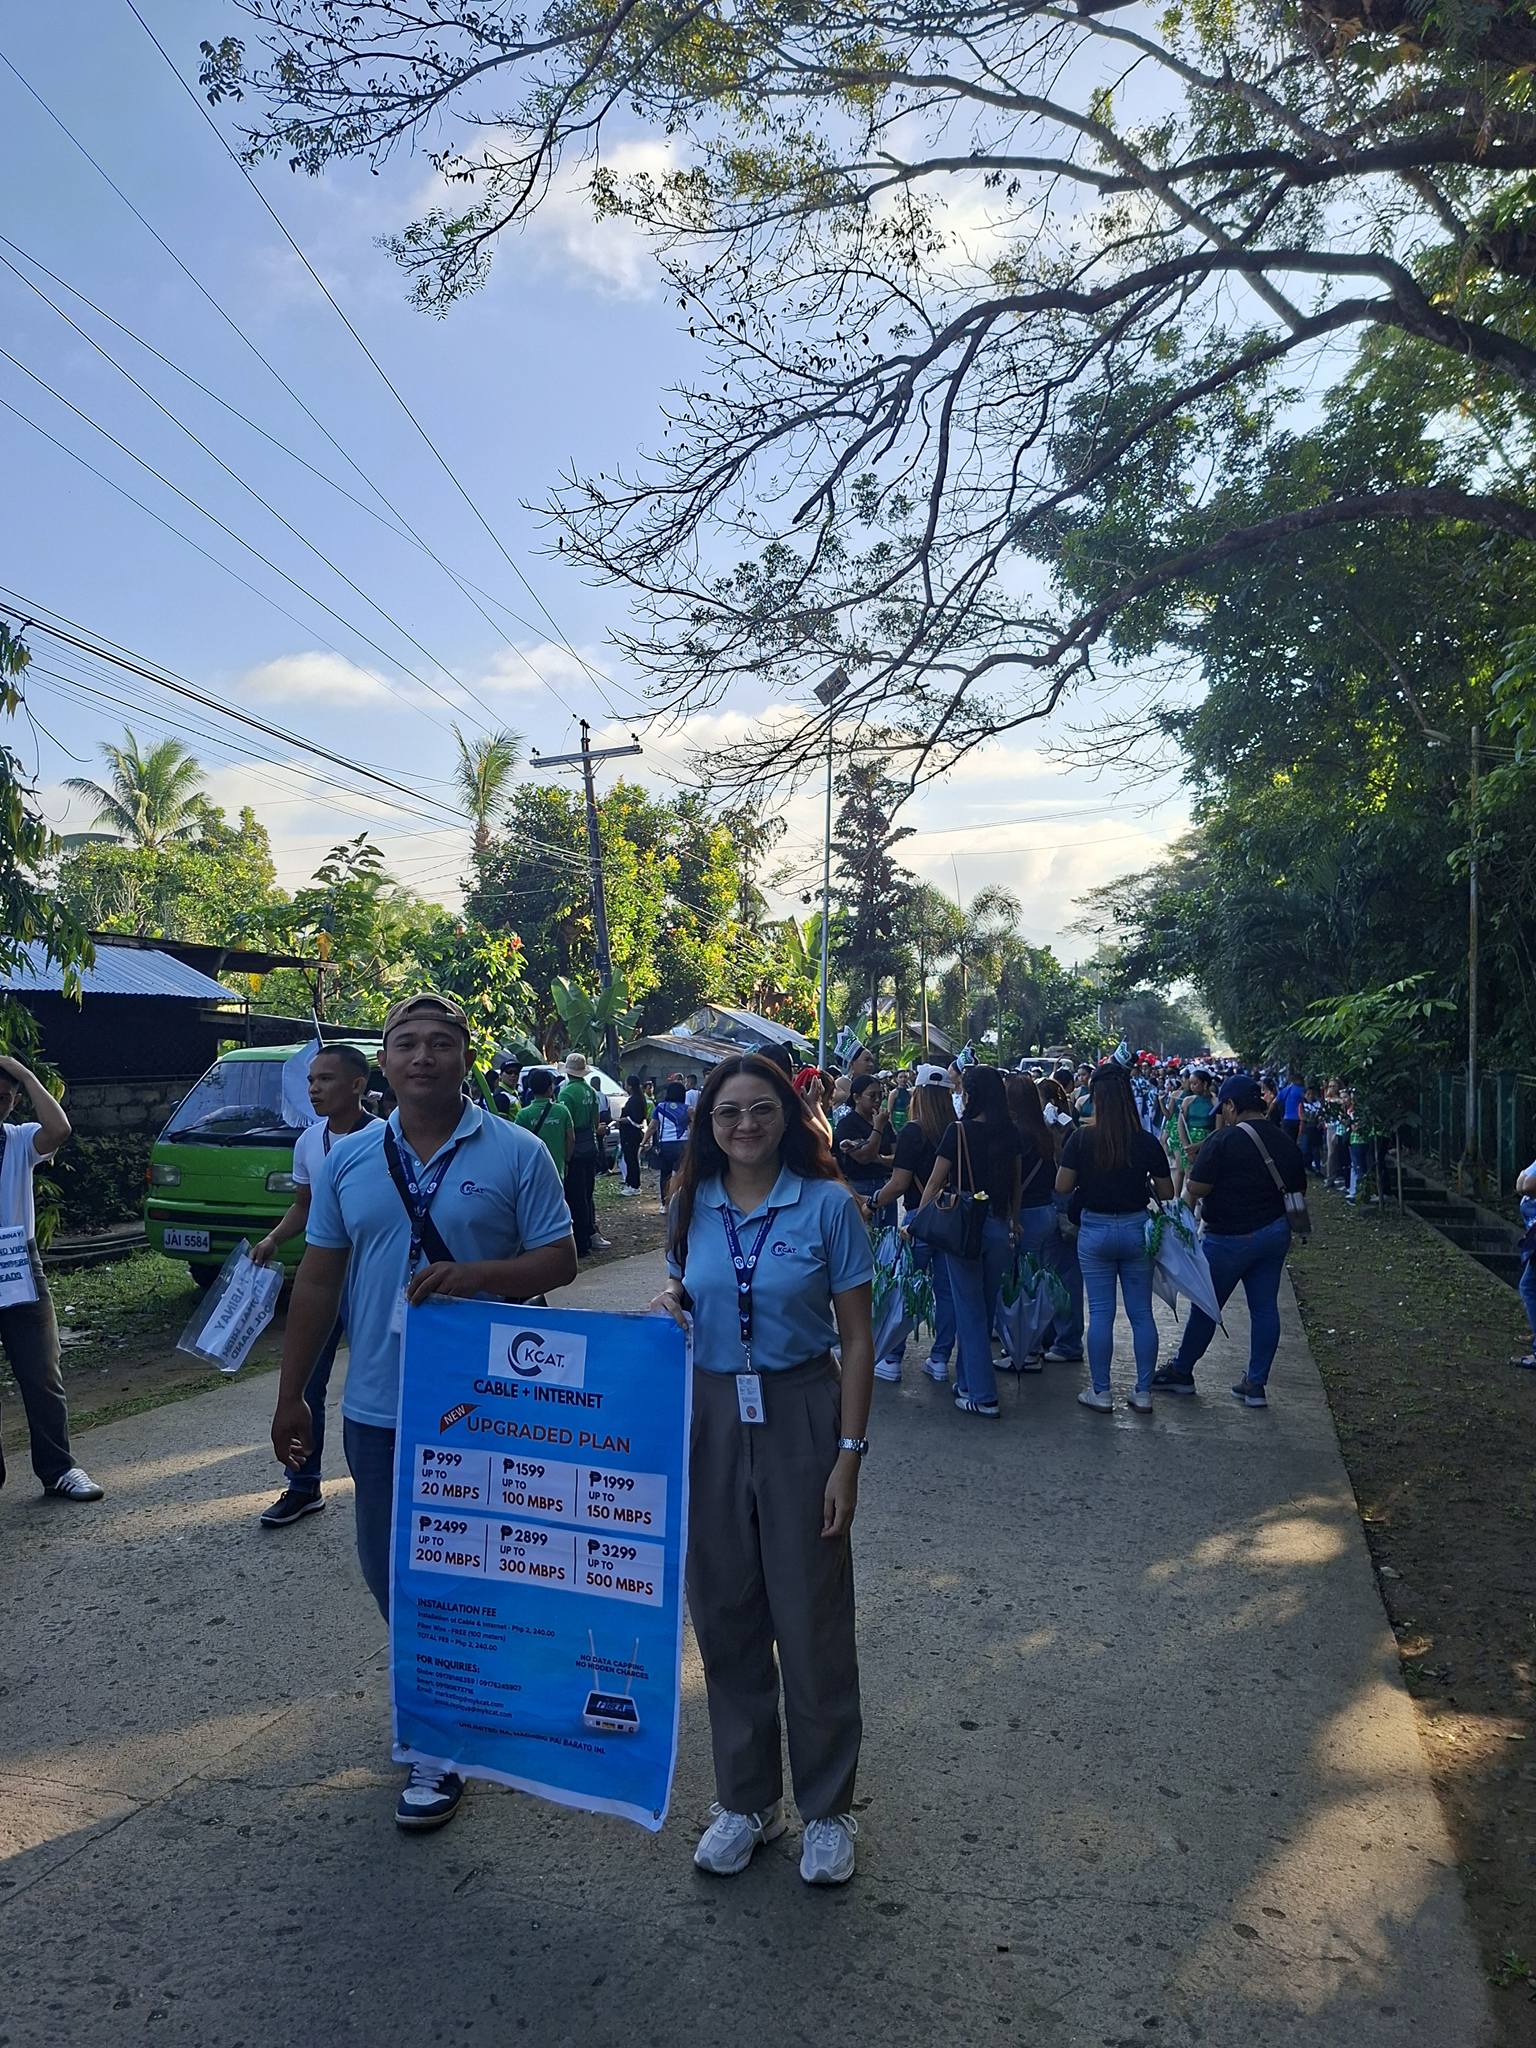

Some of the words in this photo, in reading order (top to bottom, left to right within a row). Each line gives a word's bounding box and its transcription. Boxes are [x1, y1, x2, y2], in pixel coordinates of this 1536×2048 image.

[184, 1235, 208, 1248] 5584
[473, 1379, 518, 1398] CABLE
[534, 1386, 603, 1409] INTERNET
[443, 1405, 466, 1426] NEW
[466, 1416, 573, 1443] UPGRADED
[578, 1434, 630, 1453] PLAN
[422, 1469, 434, 1478] UP
[434, 1470, 447, 1480] TO
[421, 1482, 440, 1497] 20
[442, 1484, 480, 1500] MBPS
[502, 1479, 514, 1489] UP
[515, 1480, 527, 1490] TO
[502, 1491, 525, 1506] 100
[527, 1495, 563, 1512] MBPS
[588, 1491, 601, 1501] UP
[602, 1493, 615, 1502] TO
[587, 1505, 610, 1519] 150
[613, 1508, 652, 1525] MBPS
[418, 1536, 431, 1545] UP
[431, 1537, 444, 1546] TO
[416, 1548, 442, 1563] 200
[444, 1551, 481, 1568] MBPS
[500, 1546, 512, 1555] UP
[513, 1547, 525, 1557] TO
[499, 1559, 526, 1574] 300
[529, 1562, 565, 1580] MBPS
[588, 1559, 600, 1568] UP
[601, 1560, 614, 1570] TO
[586, 1574, 612, 1588] 500
[615, 1577, 653, 1595] MBPS
[417, 1598, 480, 1615] INSTALLATION
[482, 1607, 497, 1617] FEE
[416, 1654, 432, 1665] FOR
[435, 1658, 480, 1674] INQUIRIES:
